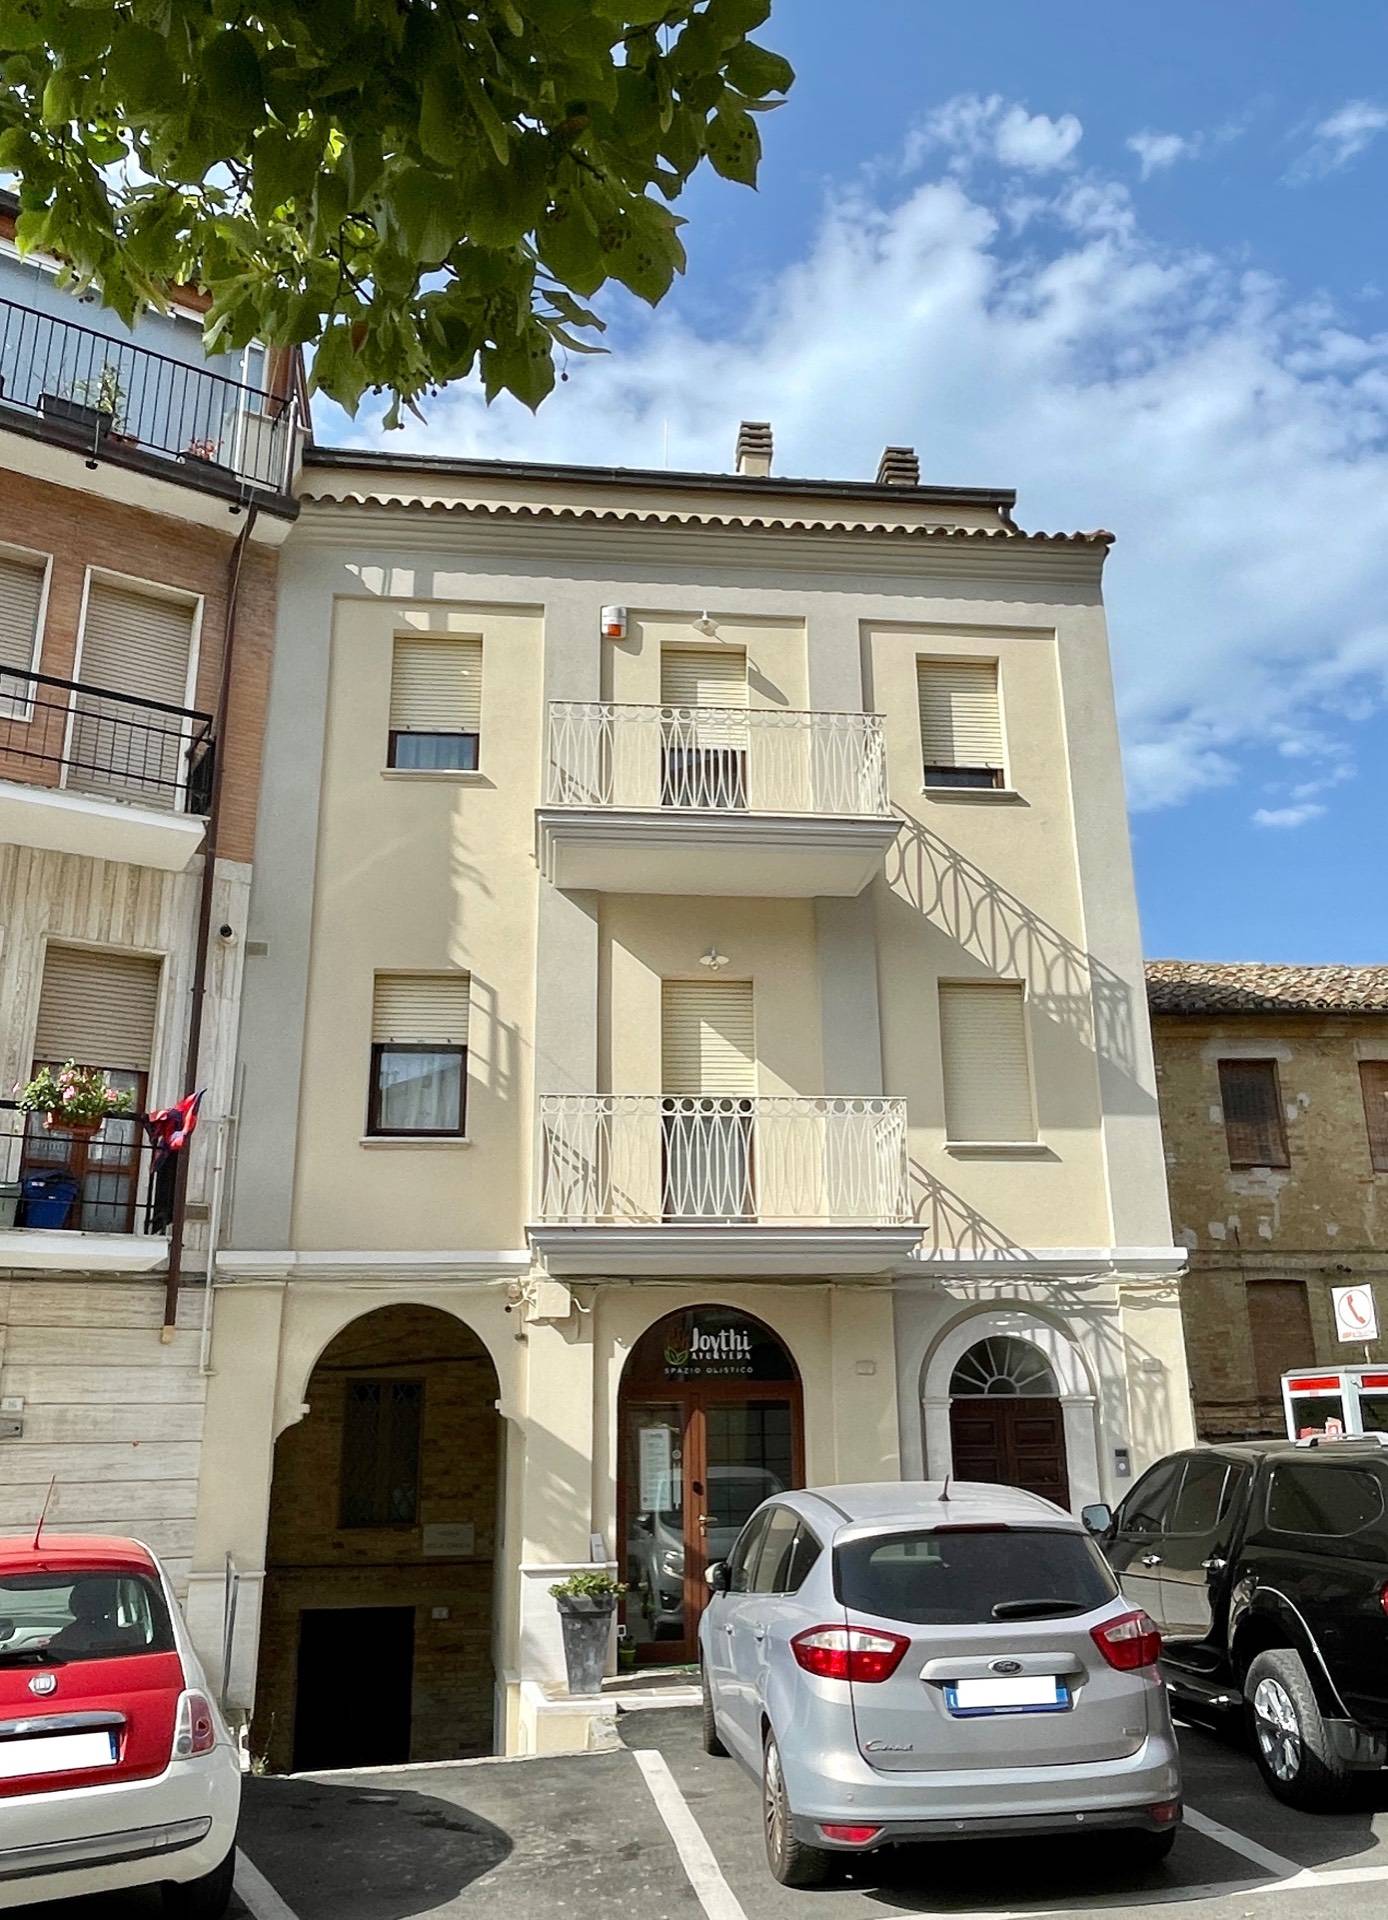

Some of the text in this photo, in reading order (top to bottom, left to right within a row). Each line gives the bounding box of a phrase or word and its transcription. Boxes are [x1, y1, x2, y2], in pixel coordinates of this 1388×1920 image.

[689, 1327, 752, 1353] Joythi
[664, 1366, 753, 1375] SPAZIO OLISTICO
